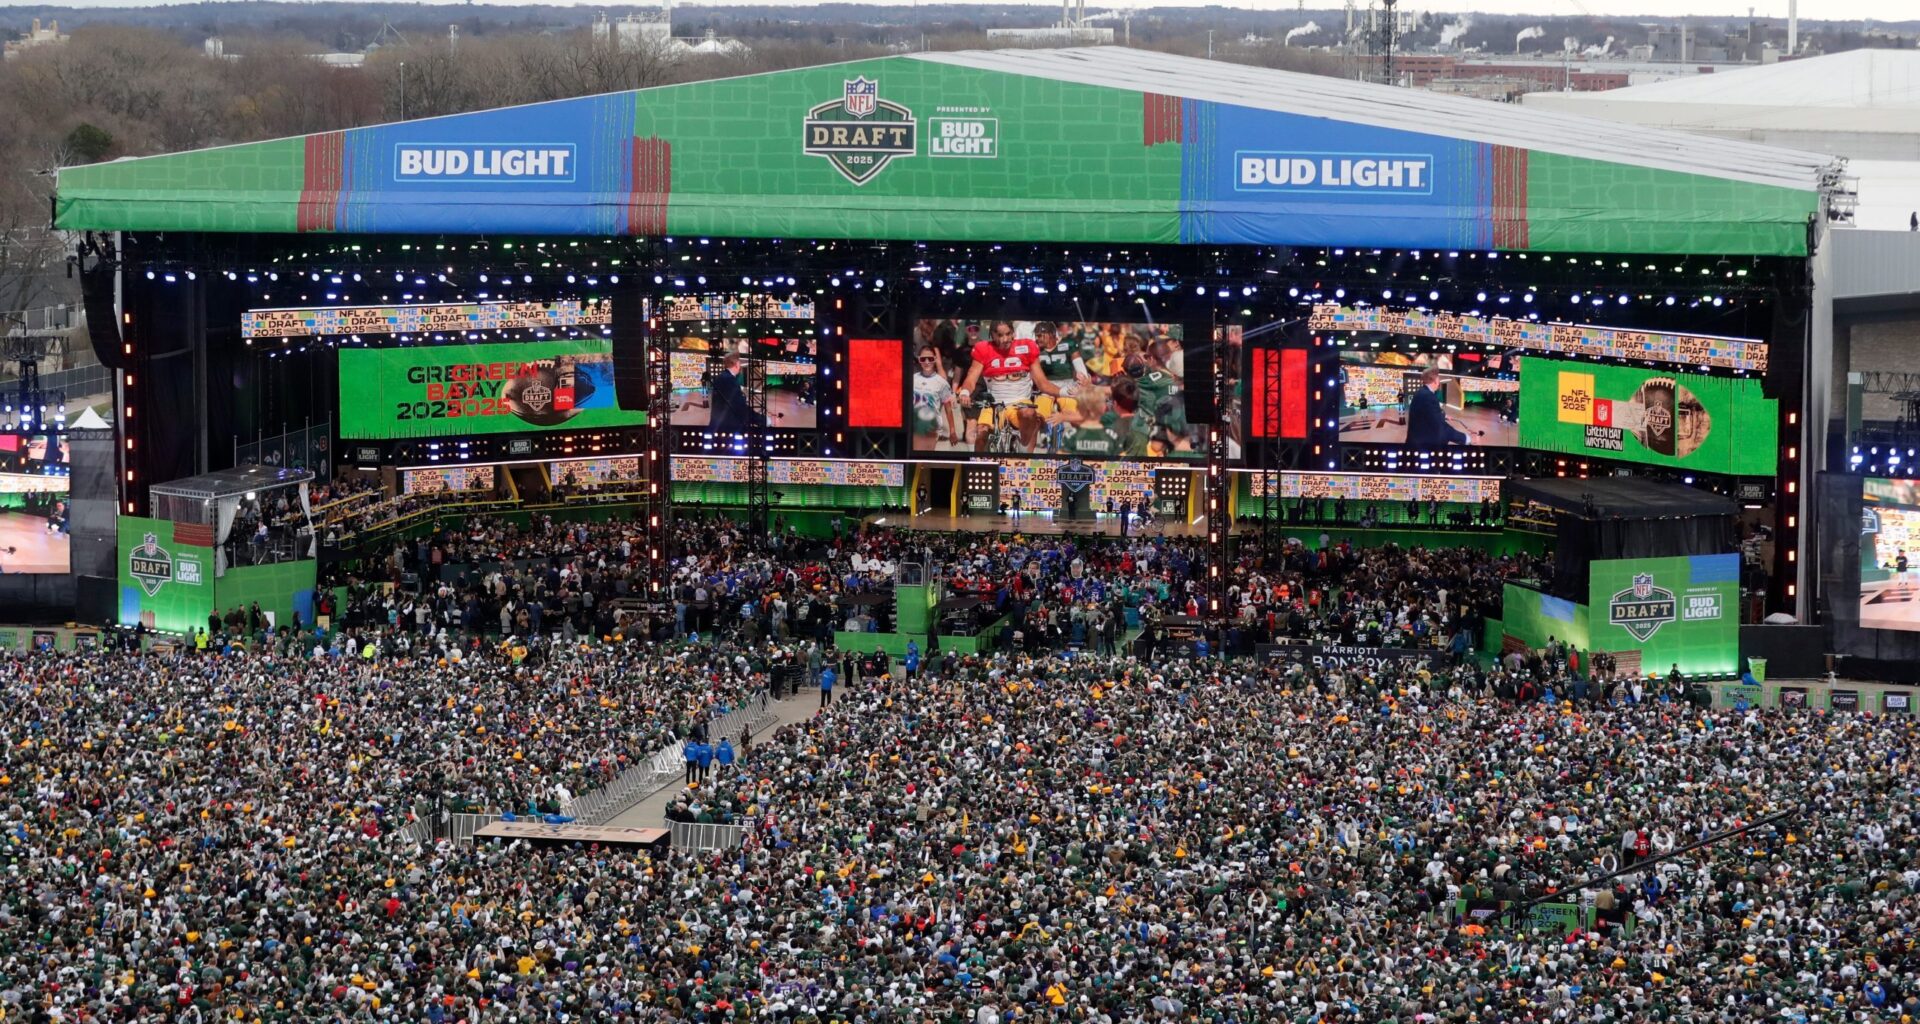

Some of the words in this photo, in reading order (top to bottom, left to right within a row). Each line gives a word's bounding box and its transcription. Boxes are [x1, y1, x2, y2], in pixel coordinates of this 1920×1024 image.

[849, 95, 873, 112] NFL
[941, 121, 985, 137] BUD
[813, 127, 907, 146] DRAFT
[932, 137, 993, 153] LIGHT
[400, 149, 469, 175] BUD
[473, 149, 570, 176] LIGHT
[846, 155, 873, 164] 2025
[1241, 158, 1316, 185] BUD
[1321, 159, 1426, 187] LIGHT
[313, 310, 336, 318] THE
[395, 308, 418, 316] THE
[513, 311, 548, 319] DRAFT
[268, 320, 305, 328] DRAFT
[351, 317, 388, 326] DRAFT
[499, 320, 526, 328] 2025
[578, 316, 605, 325] 2025
[1380, 315, 1406, 325] DRAFT
[1495, 320, 1510, 329] NFL
[337, 326, 366, 334] 2025
[419, 323, 447, 331] 2025
[1307, 322, 1337, 330] 2025
[1388, 325, 1408, 334] 2025
[1436, 322, 1463, 332] DRAFT
[1554, 326, 1570, 335] NFL
[254, 329, 283, 337] 2025
[1445, 330, 1465, 340] 2025
[1494, 328, 1521, 338] DRAFT
[1616, 331, 1633, 341] NFL
[1503, 337, 1524, 347] 2025
[1554, 334, 1581, 344] DRAFT
[1680, 336, 1697, 347] NFL
[1562, 344, 1584, 353] 2025
[1615, 340, 1645, 350] DRAFT
[1746, 343, 1765, 353] NFL
[1625, 349, 1647, 360] 2025
[1679, 345, 1710, 356] DRAFT
[1689, 355, 1711, 365] 2025
[450, 361, 538, 381] GREEN
[427, 382, 480, 401] BAY
[1571, 389, 1588, 398] NFL
[1561, 395, 1592, 406] DRAFT
[446, 398, 512, 418] 2025
[1563, 402, 1586, 411] 2025
[145, 543, 156, 553] NFL
[133, 560, 169, 575] DRAFT
[179, 562, 197, 573] BUD
[177, 571, 200, 582] LIGHT
[1635, 584, 1650, 594] NFL
[1689, 597, 1714, 607] BUD
[1615, 603, 1671, 618] DRAFT
[1684, 606, 1719, 618] LIGHT
[1323, 646, 1378, 655] MARRIOTT
[1567, 893, 1577, 902] 28
[1541, 907, 1577, 916] GREEN
